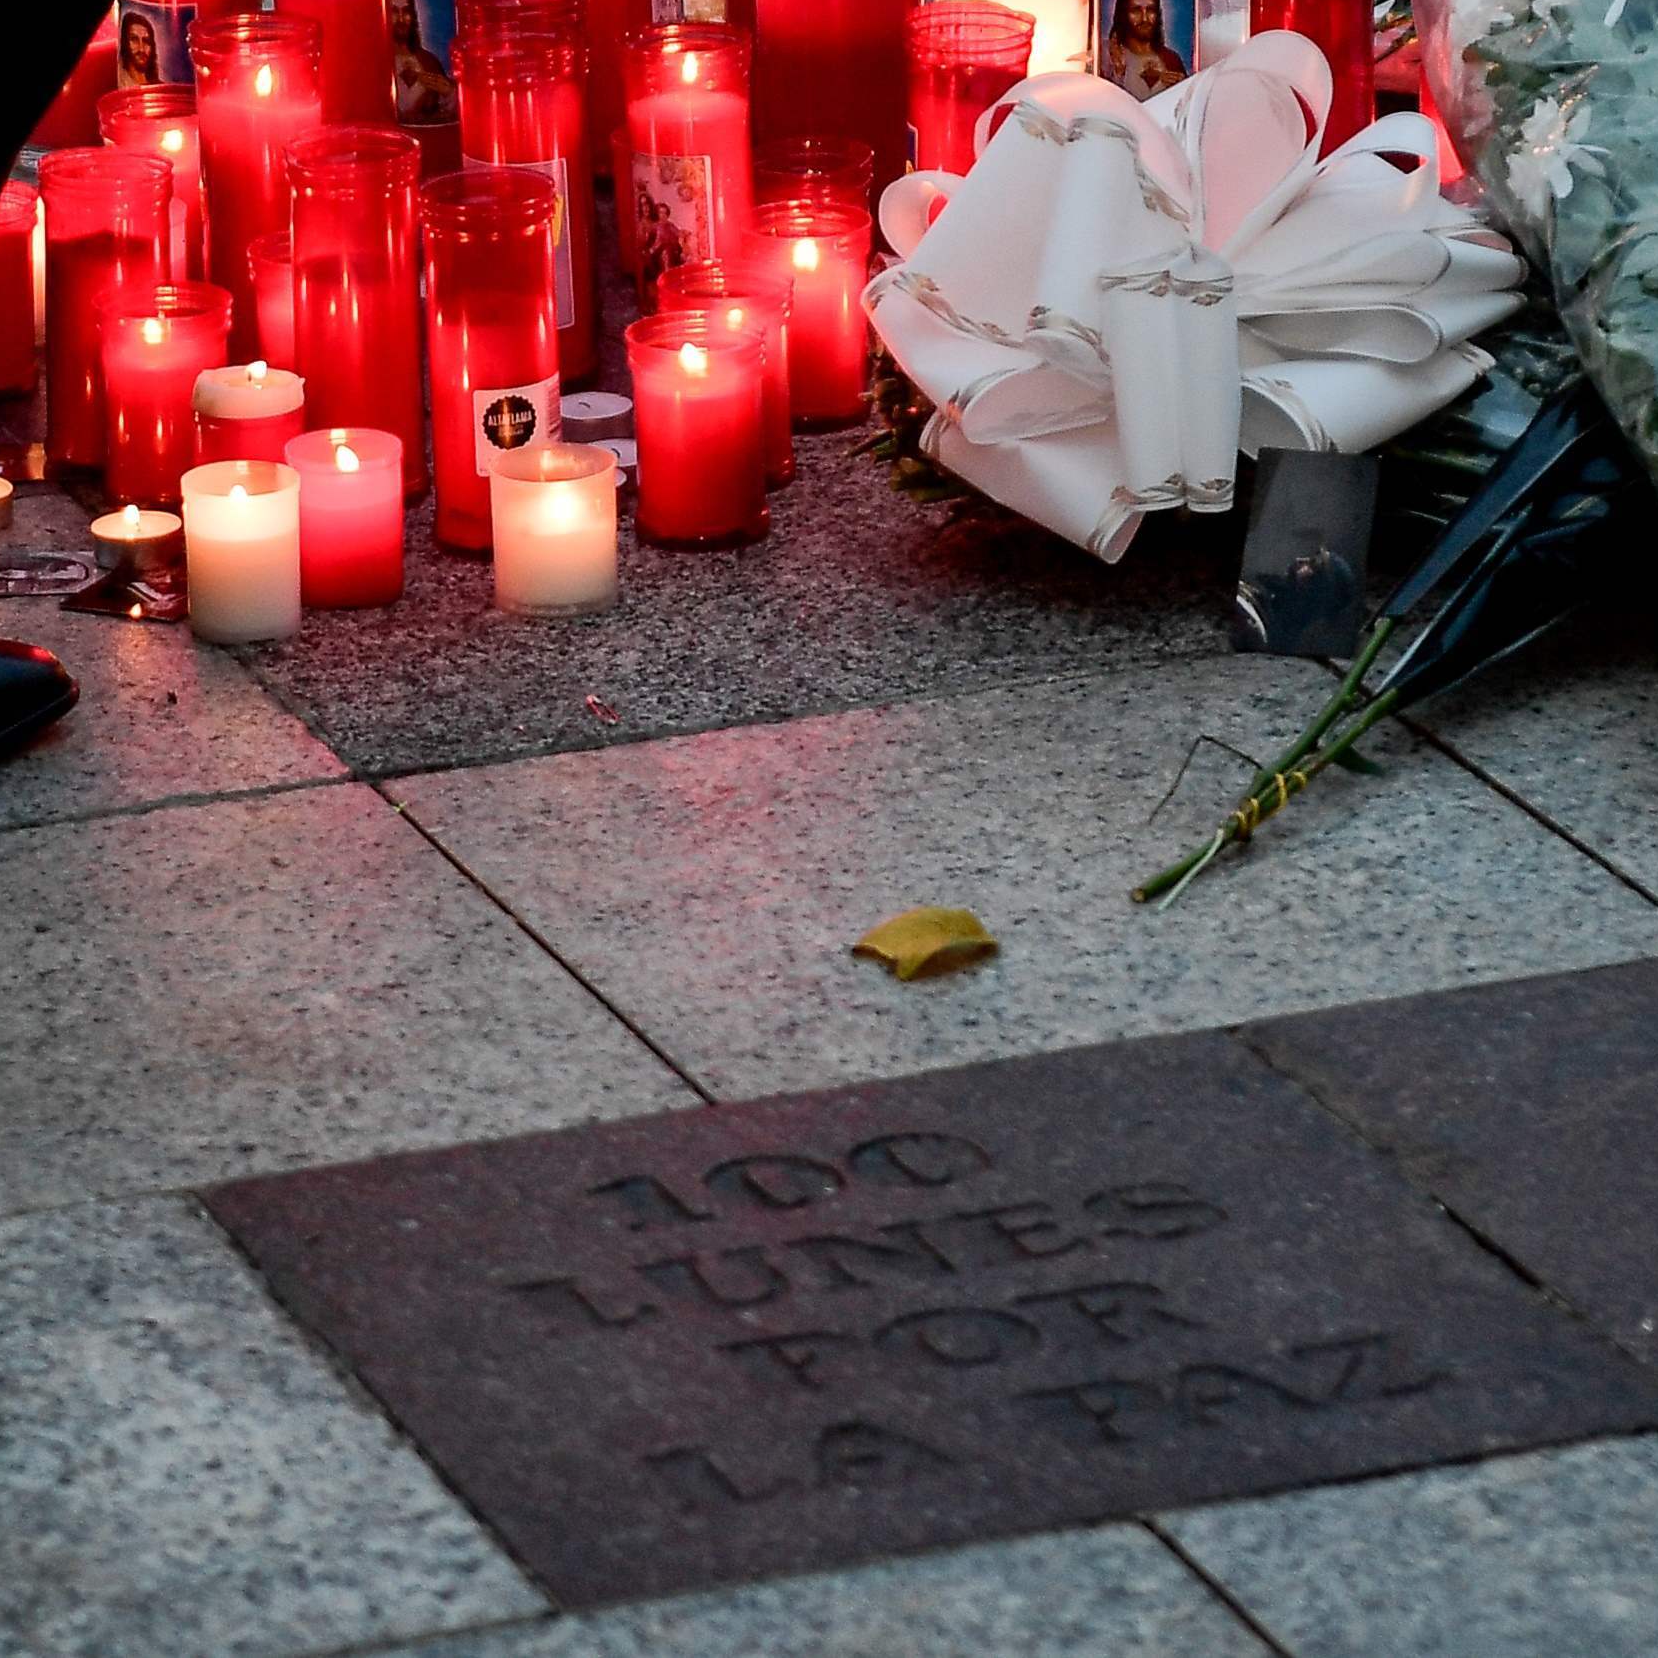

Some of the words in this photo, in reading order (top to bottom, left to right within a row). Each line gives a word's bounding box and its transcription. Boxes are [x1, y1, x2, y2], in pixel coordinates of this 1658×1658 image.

[587, 1131, 994, 1230] 100
[505, 1182, 1230, 1328] LUNES
[712, 1280, 1210, 1390] POR
[640, 1420, 964, 1510] LA
[1010, 1334, 1452, 1442] PAZ
